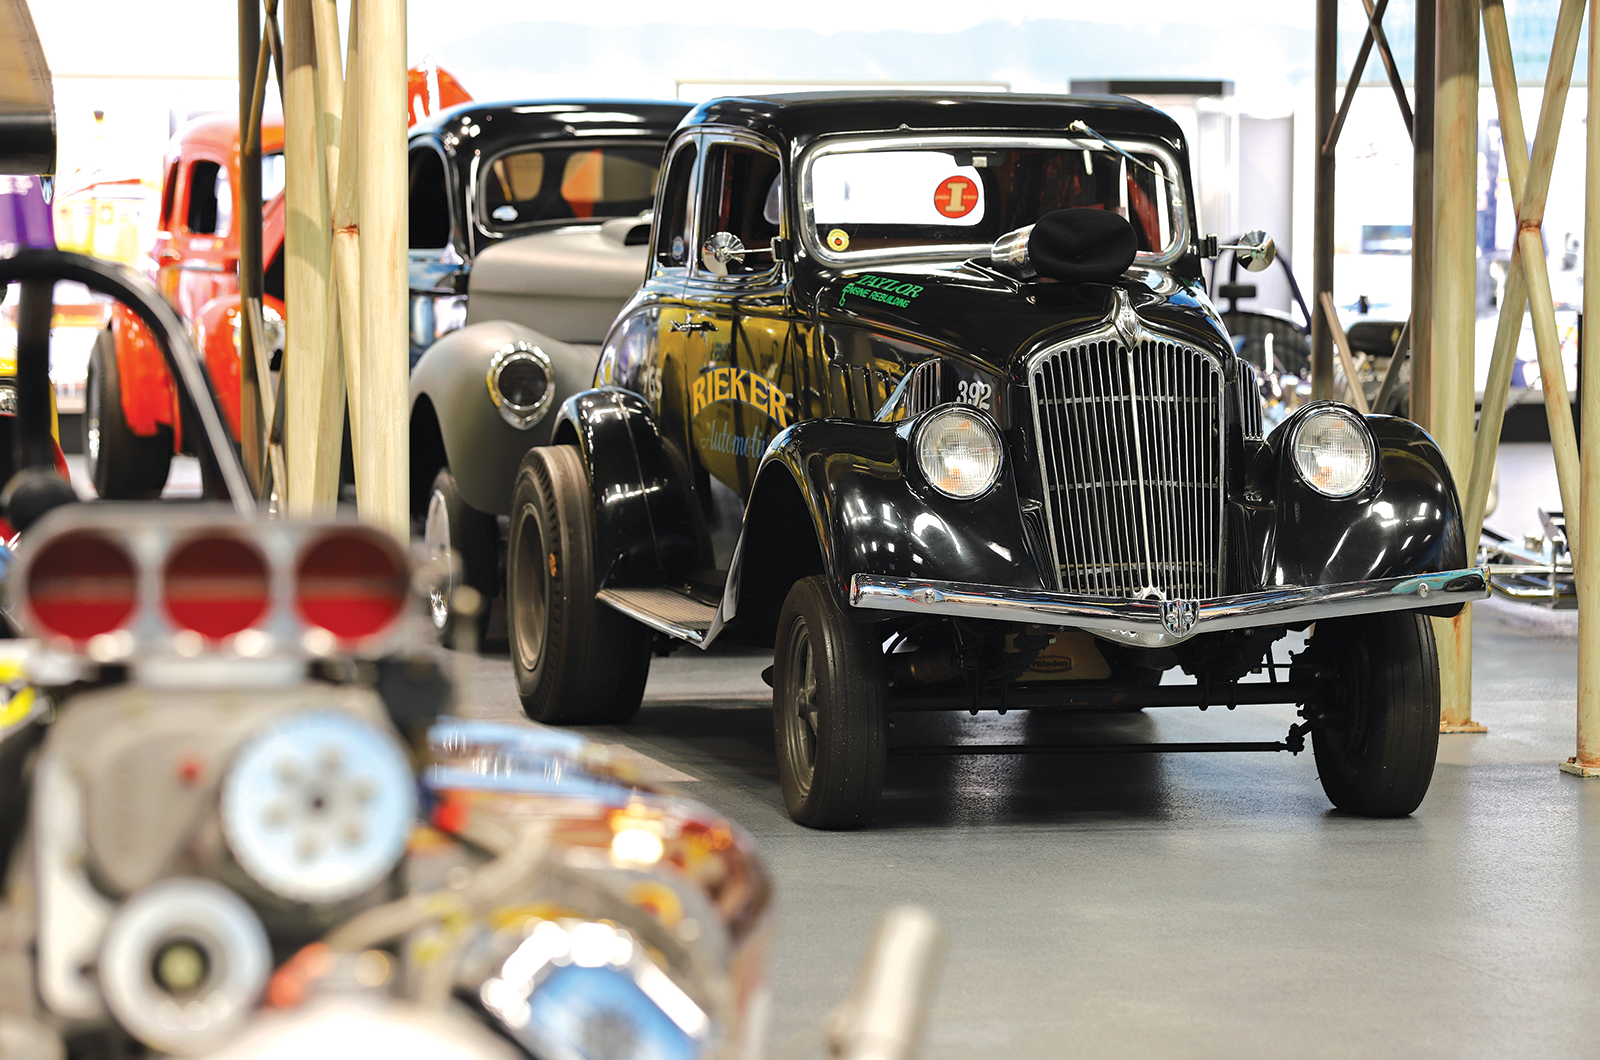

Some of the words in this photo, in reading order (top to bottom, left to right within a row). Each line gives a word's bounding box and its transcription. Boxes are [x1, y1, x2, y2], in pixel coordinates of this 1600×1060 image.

[842, 283, 871, 298] ENGINE
[868, 290, 911, 309] REBUILDING
[855, 274, 924, 298] TAYLOR
[692, 367, 787, 429] RIEKER
[956, 380, 992, 411] 392
